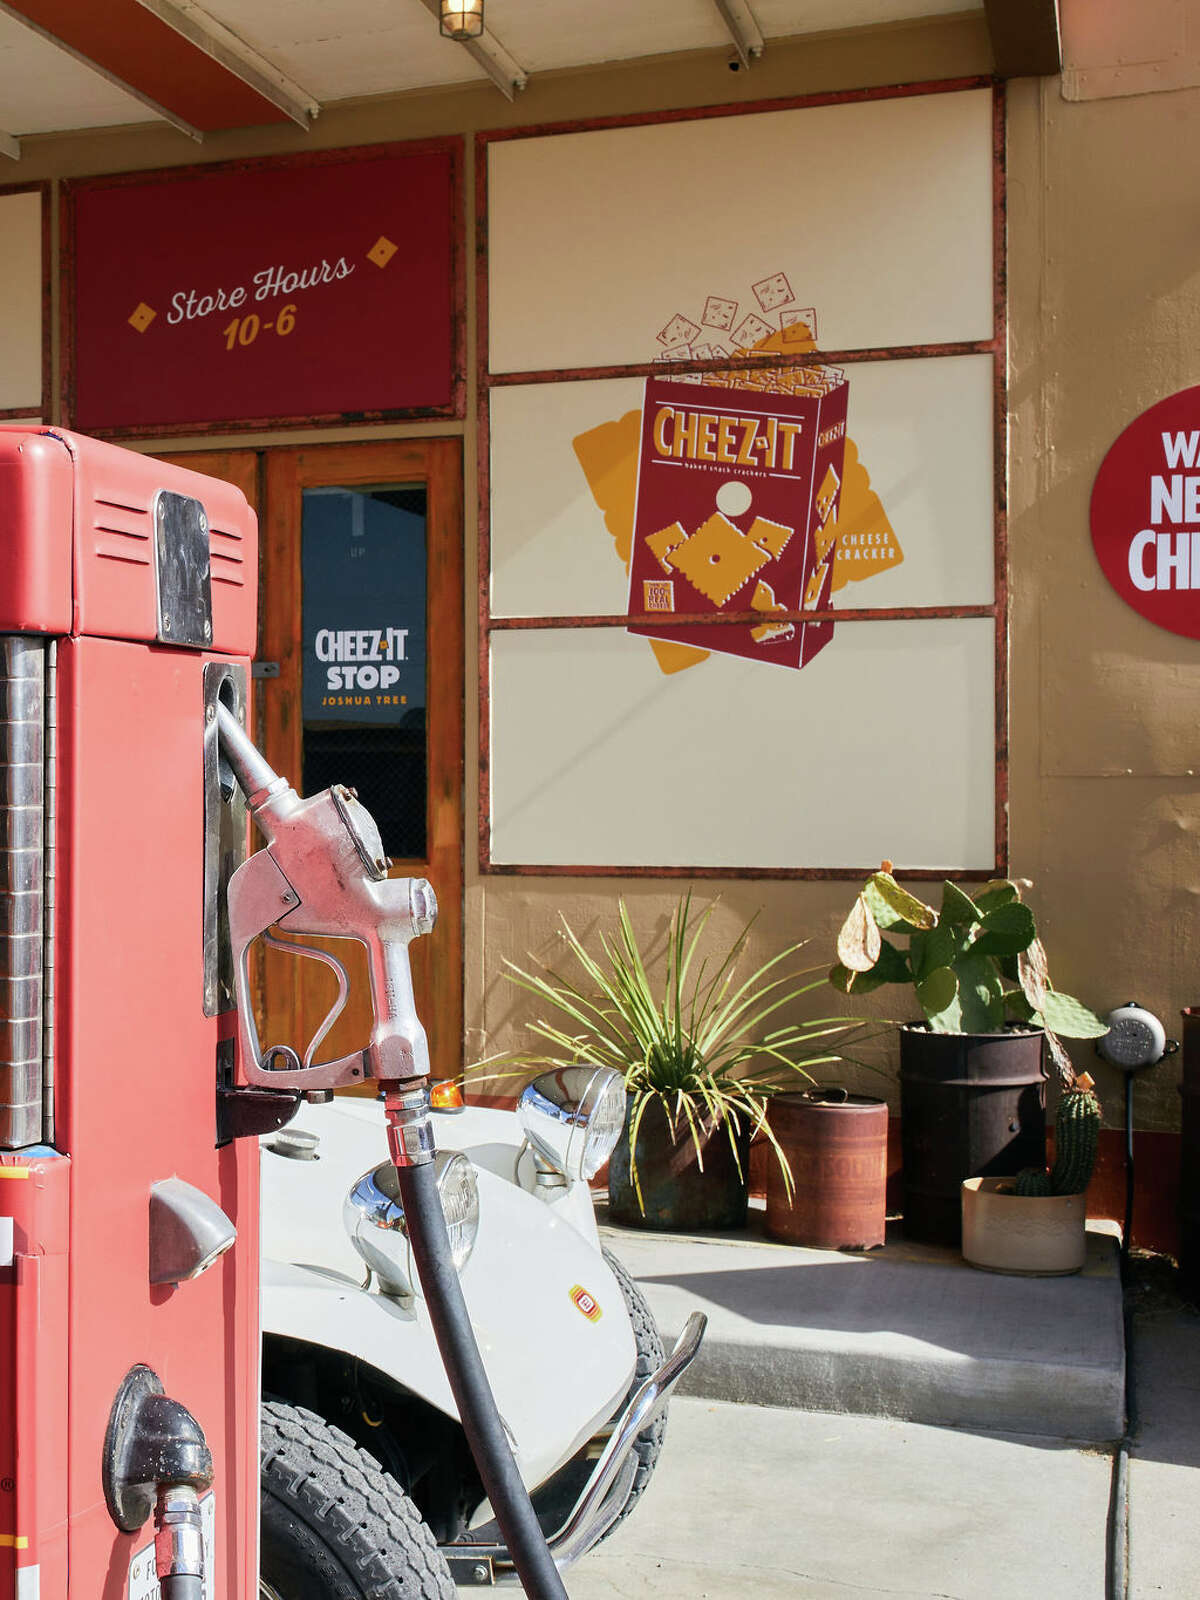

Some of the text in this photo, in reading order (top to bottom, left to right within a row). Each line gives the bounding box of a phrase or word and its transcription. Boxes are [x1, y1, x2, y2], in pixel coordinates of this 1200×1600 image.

[166, 256, 356, 325] Store Hours
[223, 304, 297, 351] 10-6
[842, 532, 889, 545] CHEESE
[836, 547, 895, 561] CRACKER
[326, 664, 401, 691] STOP
[321, 695, 408, 706] JOSHUA TREE
